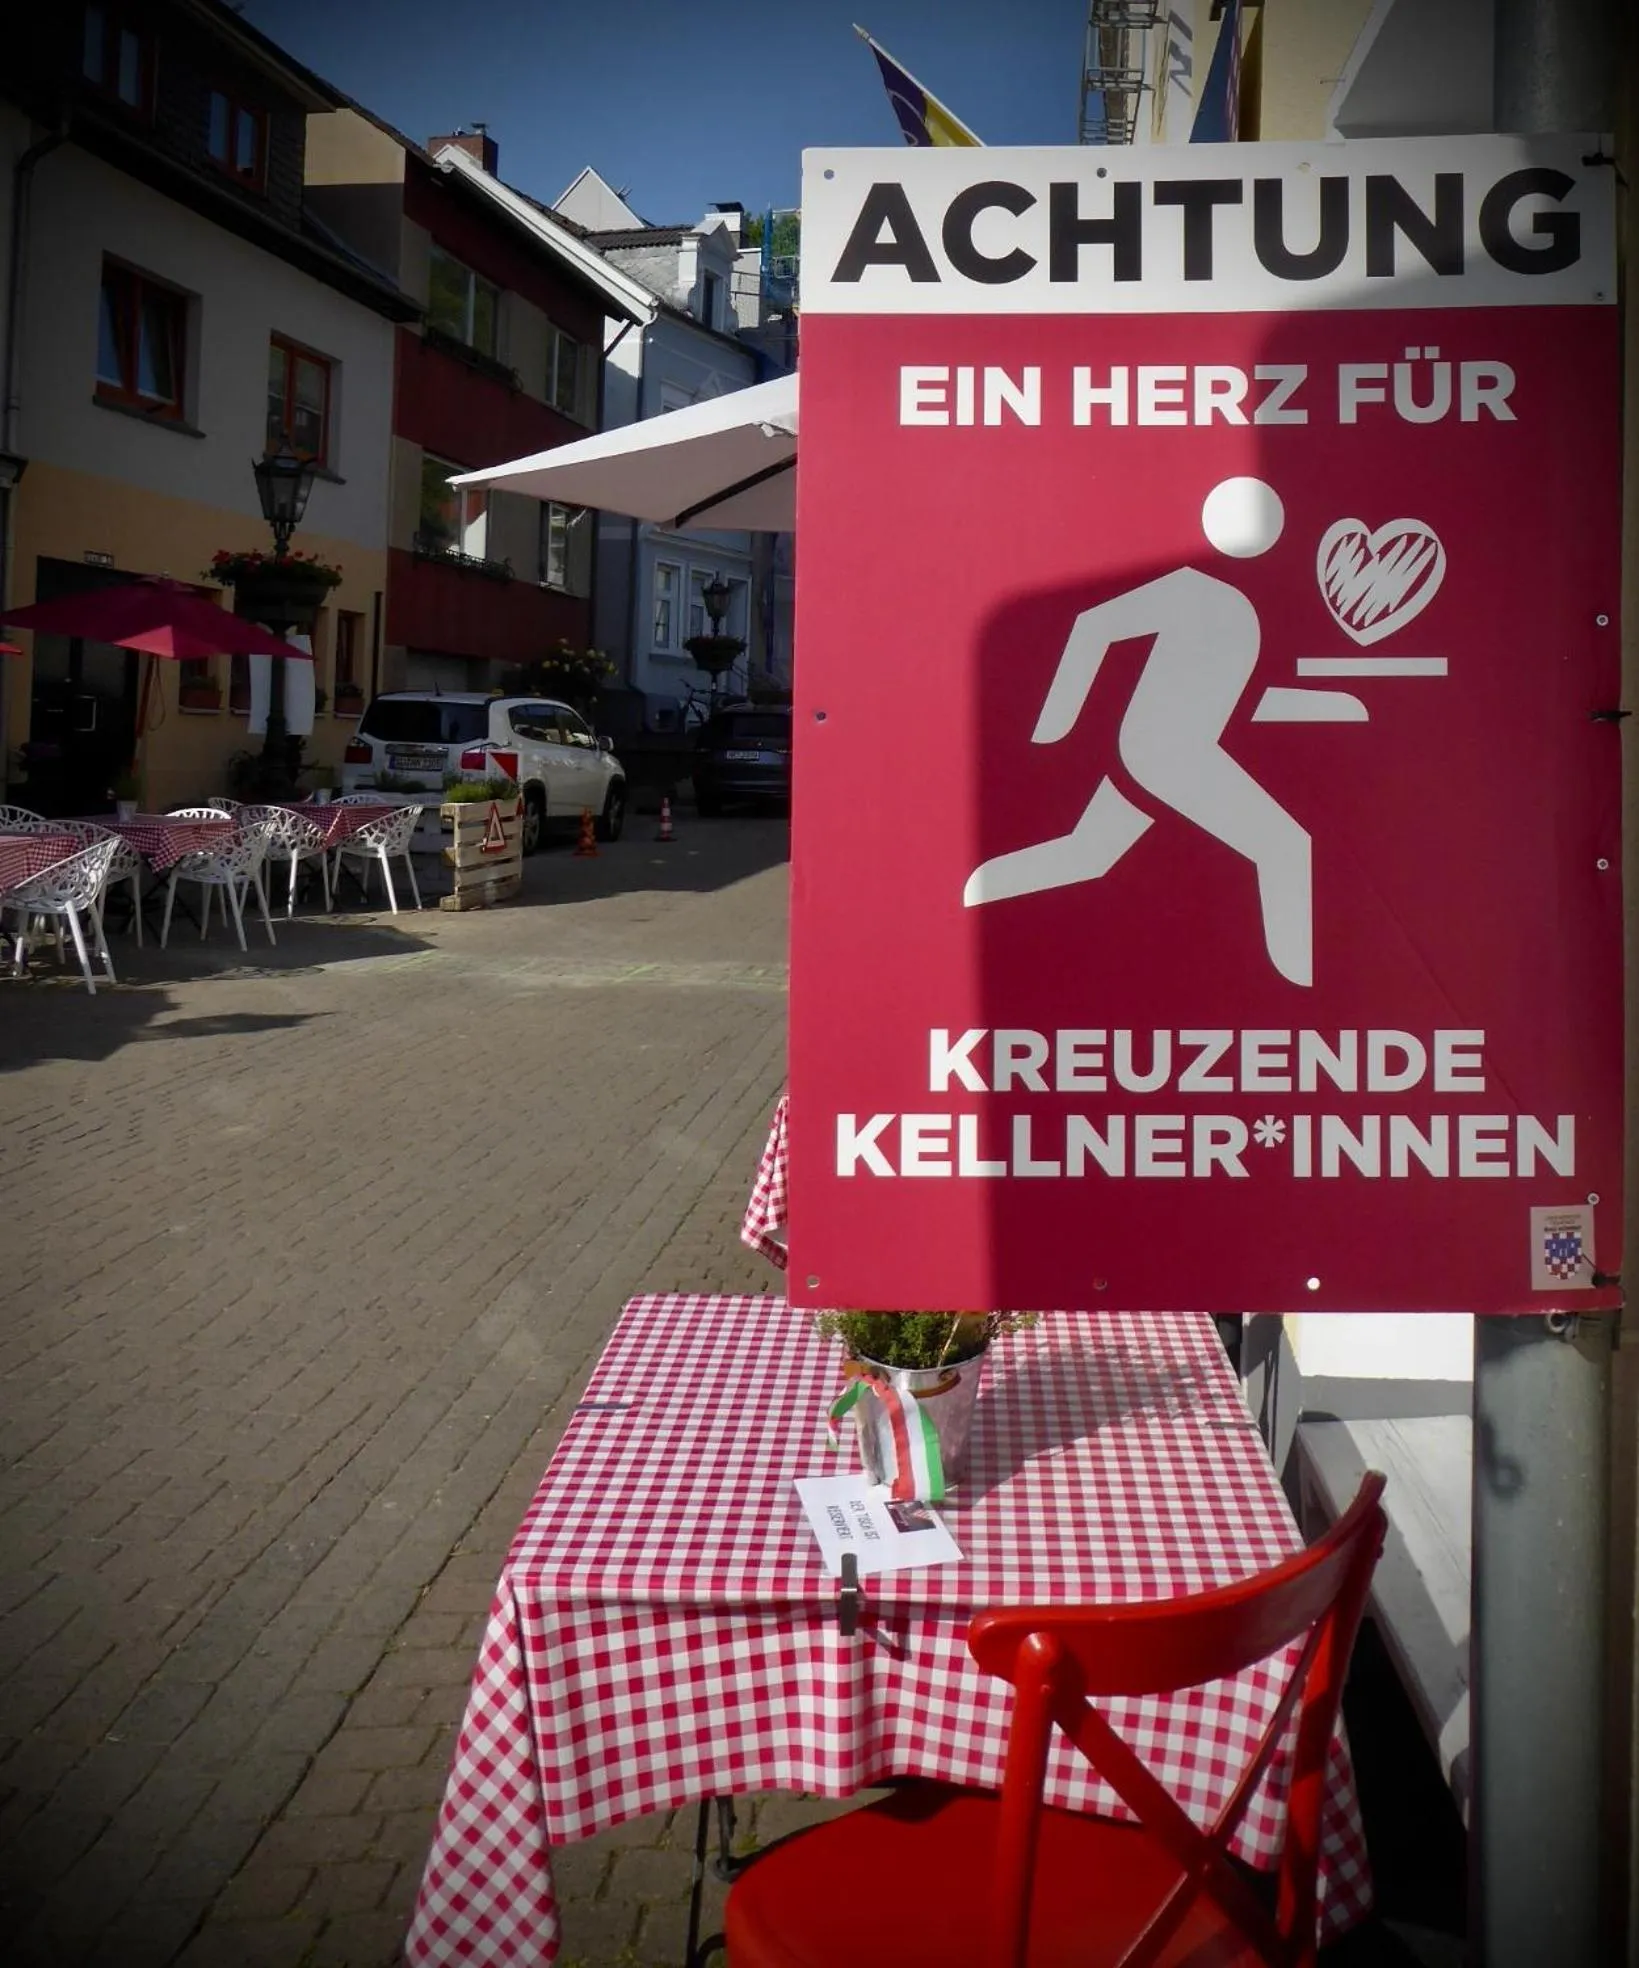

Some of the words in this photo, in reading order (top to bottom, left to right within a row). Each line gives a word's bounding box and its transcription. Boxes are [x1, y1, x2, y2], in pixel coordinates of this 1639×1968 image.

[830, 168, 1581, 284] ACHTUNG
[899, 366, 1041, 426] EIN
[1073, 365, 1307, 426] HERZ
[1339, 347, 1516, 423] FÜR
[929, 1028, 1485, 1092] KREUZENDE
